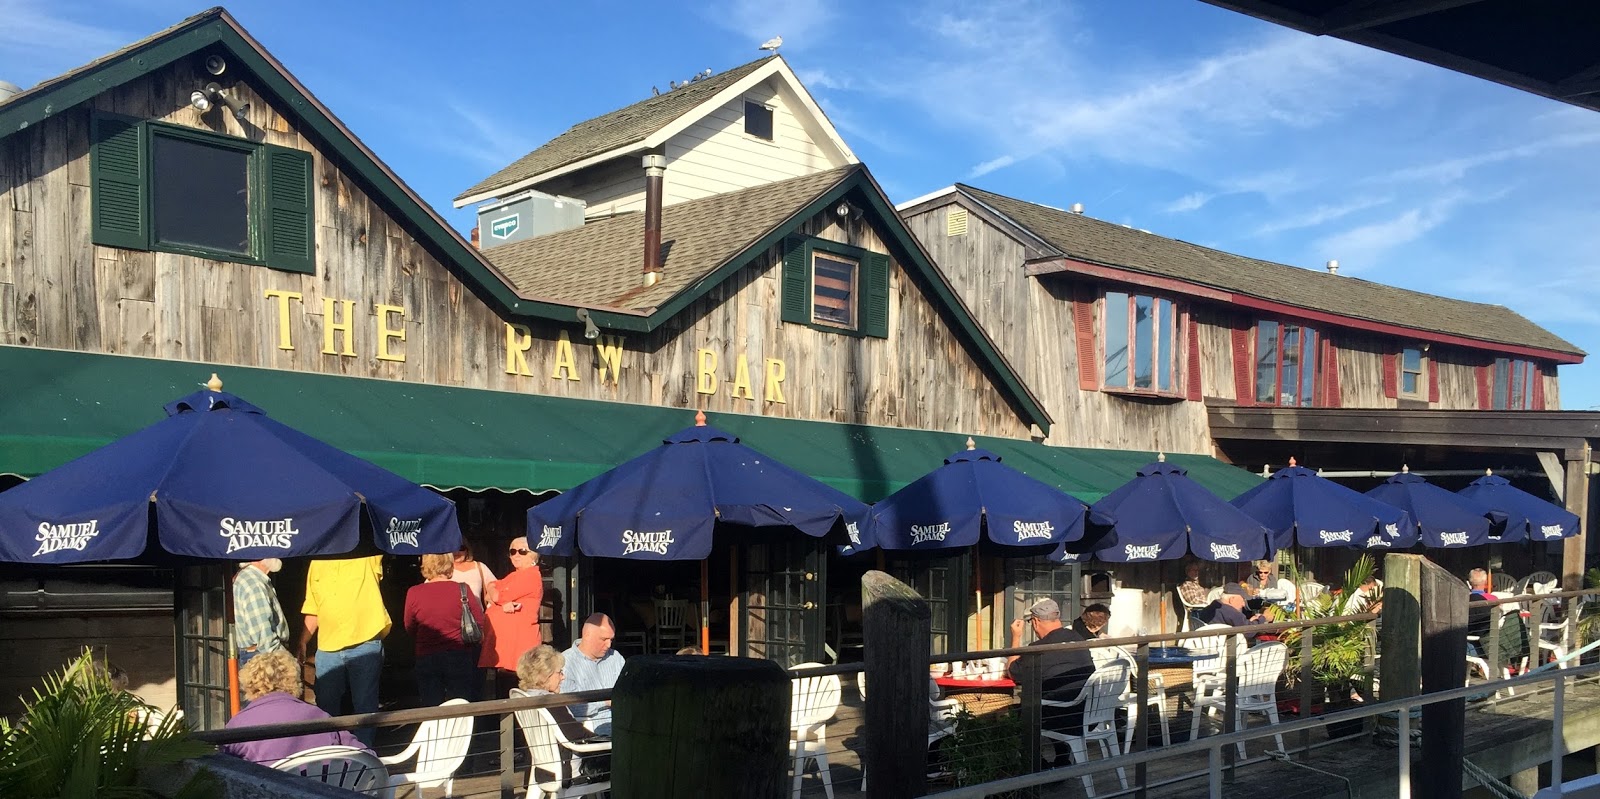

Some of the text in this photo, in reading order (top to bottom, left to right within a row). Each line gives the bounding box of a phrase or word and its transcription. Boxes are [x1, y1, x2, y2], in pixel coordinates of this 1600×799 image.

[264, 289, 787, 404] THE RAW BAR
[35, 519, 99, 541] SAMUEL
[220, 517, 299, 537] SAMUEL
[910, 521, 951, 537] SAMUEL
[1013, 520, 1054, 532] SAMUEL
[390, 531, 419, 549] ADAMS
[622, 529, 675, 543] SAMUEL
[911, 531, 947, 546] ADAMS
[1018, 529, 1052, 542] ADAMS
[32, 536, 92, 557] ADAMS
[226, 534, 293, 554] ADAMS
[622, 542, 669, 555] ADAMS
[1125, 544, 1162, 554] SAMUEL
[1210, 542, 1241, 553] SAMUEL
[1126, 551, 1158, 561] ADAMS
